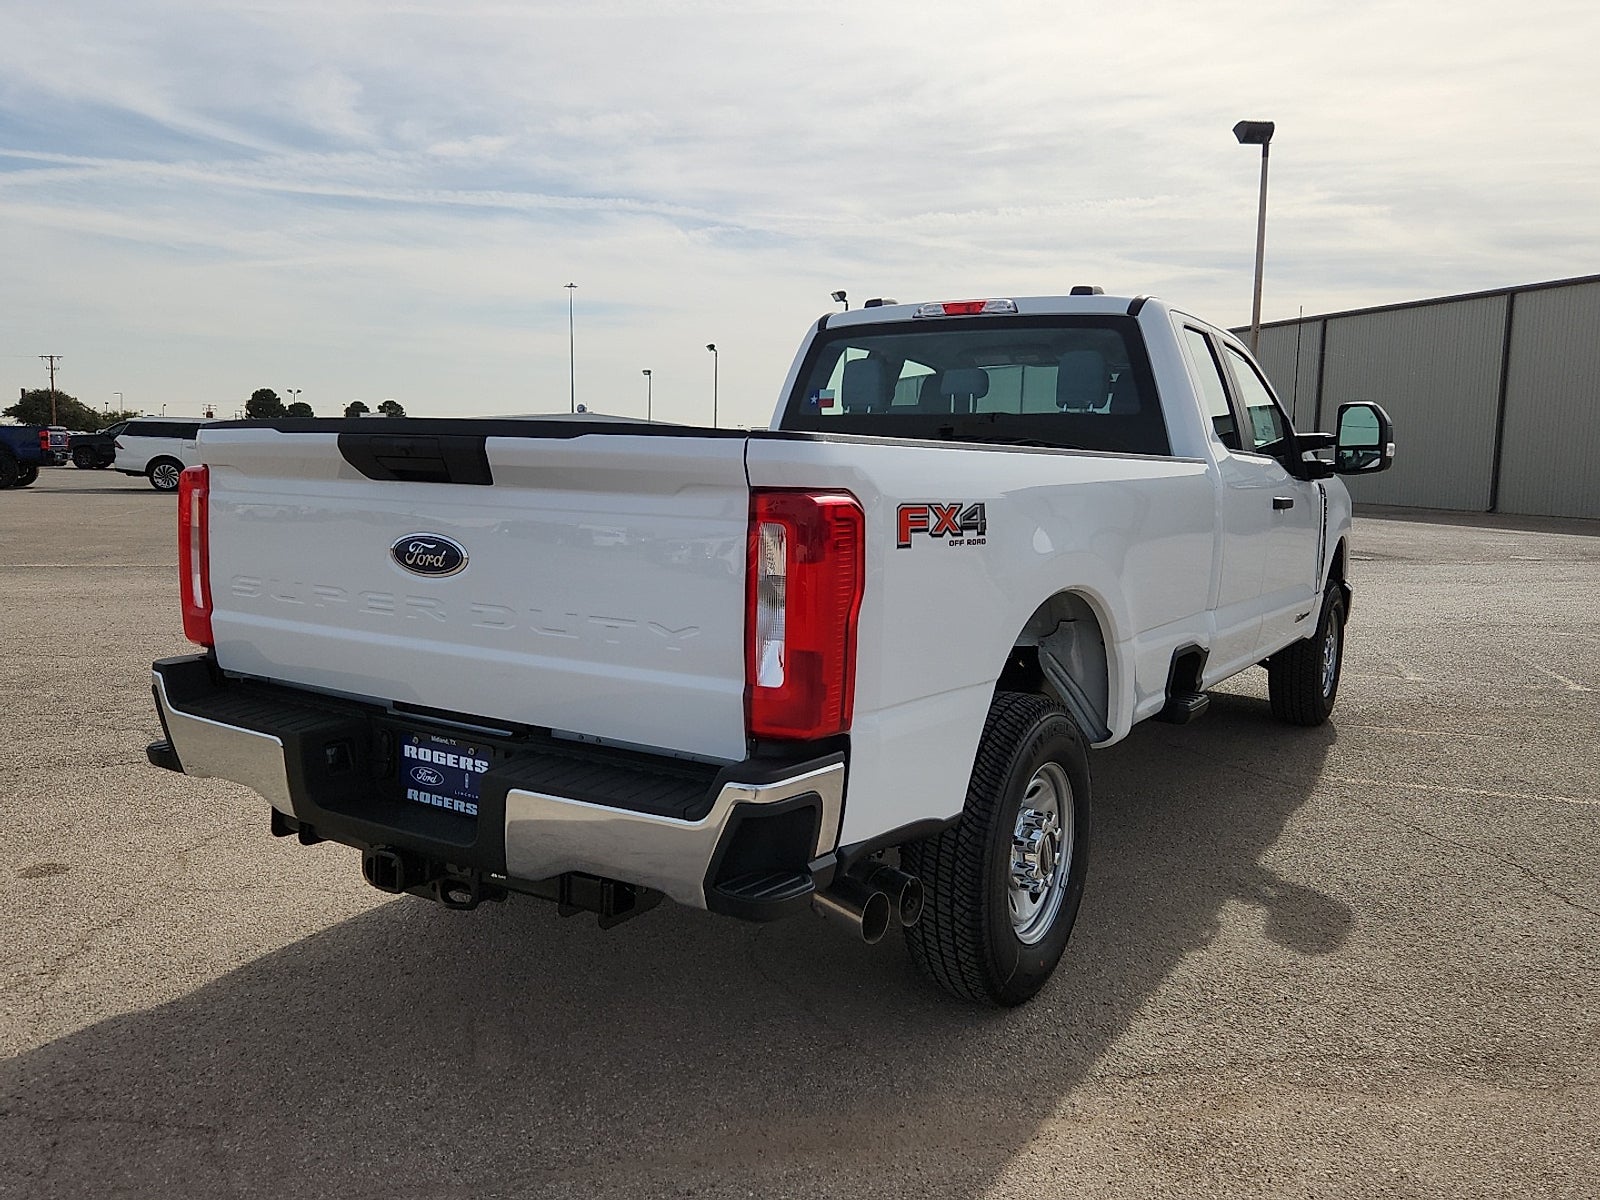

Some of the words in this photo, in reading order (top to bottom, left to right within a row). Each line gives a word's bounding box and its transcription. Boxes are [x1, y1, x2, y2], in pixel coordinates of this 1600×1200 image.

[897, 503, 986, 549] FX4
[405, 541, 447, 567] Ford
[949, 539, 964, 547] OFF
[967, 538, 986, 546] ROAD
[231, 574, 447, 622] SUPER
[471, 602, 700, 652] DUTY
[404, 744, 489, 774] ROGERS
[416, 768, 437, 783] Ford
[407, 788, 478, 815] ROGERS
